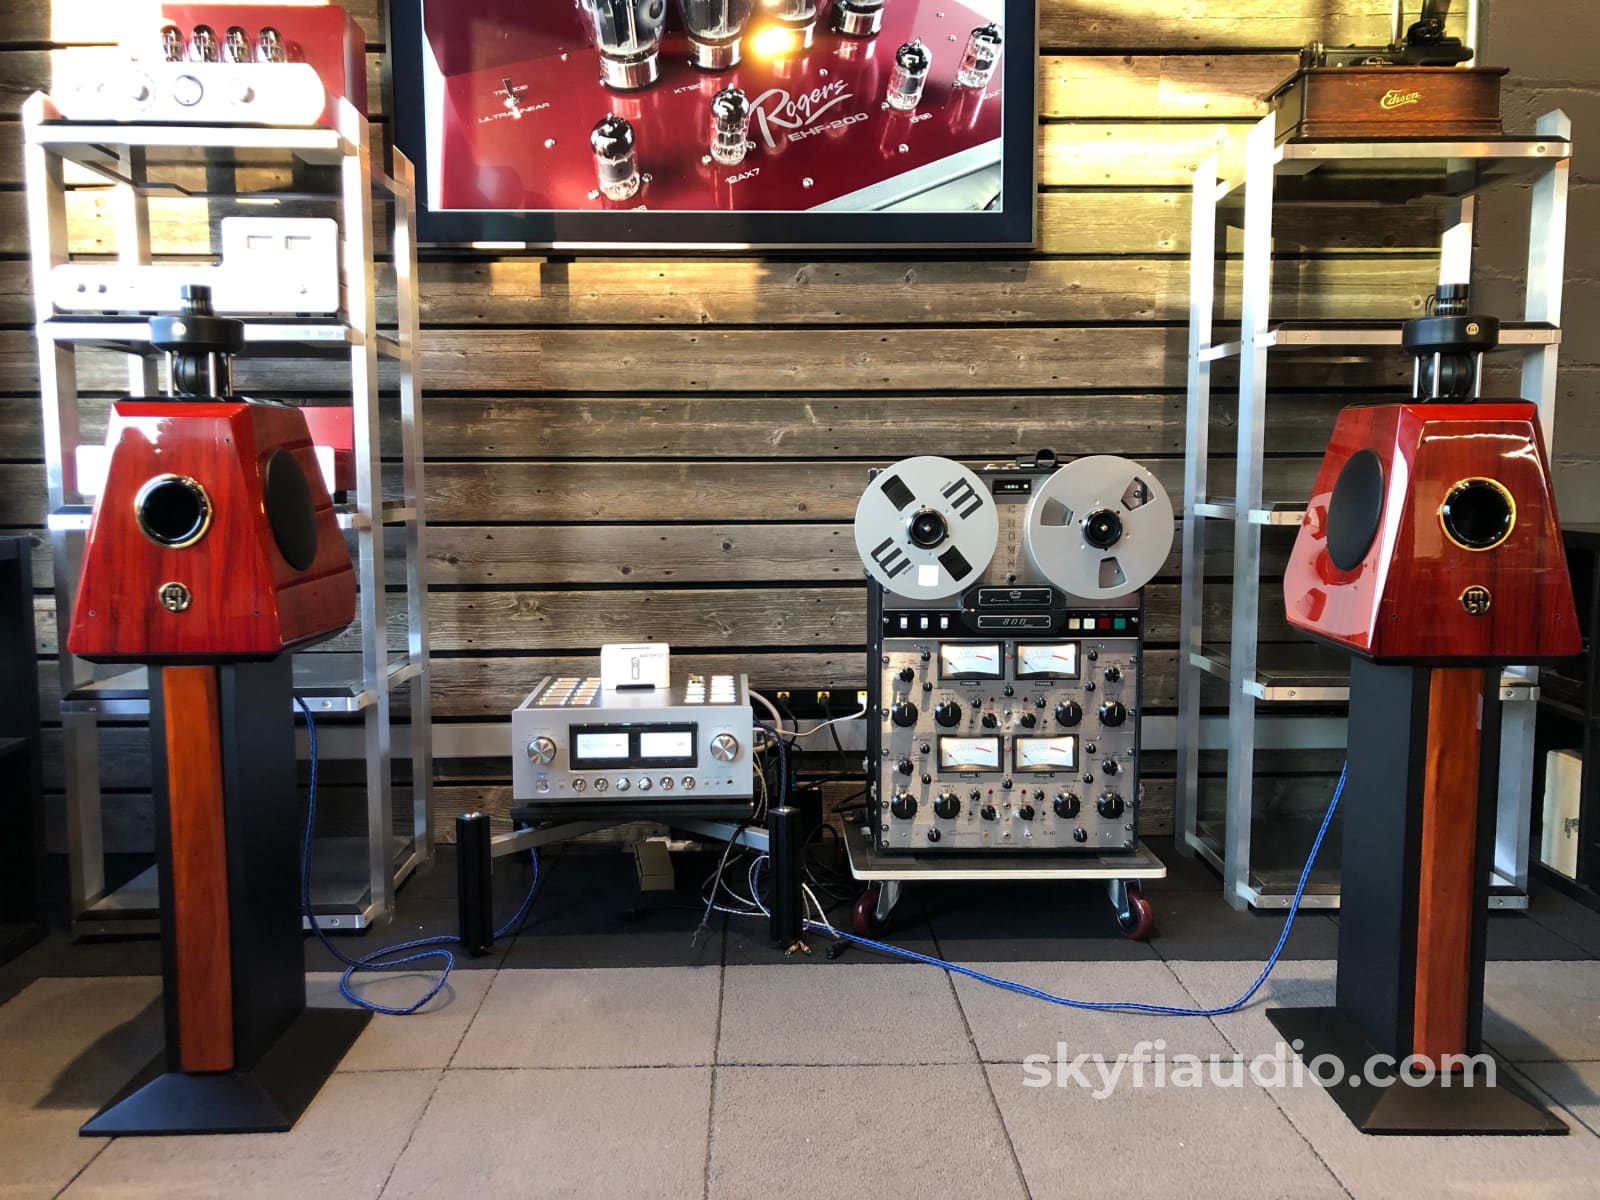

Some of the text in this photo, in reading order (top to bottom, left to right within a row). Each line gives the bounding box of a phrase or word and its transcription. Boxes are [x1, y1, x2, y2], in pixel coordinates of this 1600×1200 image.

[1381, 89, 1421, 109] Edison
[748, 79, 850, 148] Rogers
[787, 112, 869, 142] EHF-200
[724, 167, 760, 184] 12AX7
[1002, 617, 1028, 626] 800
